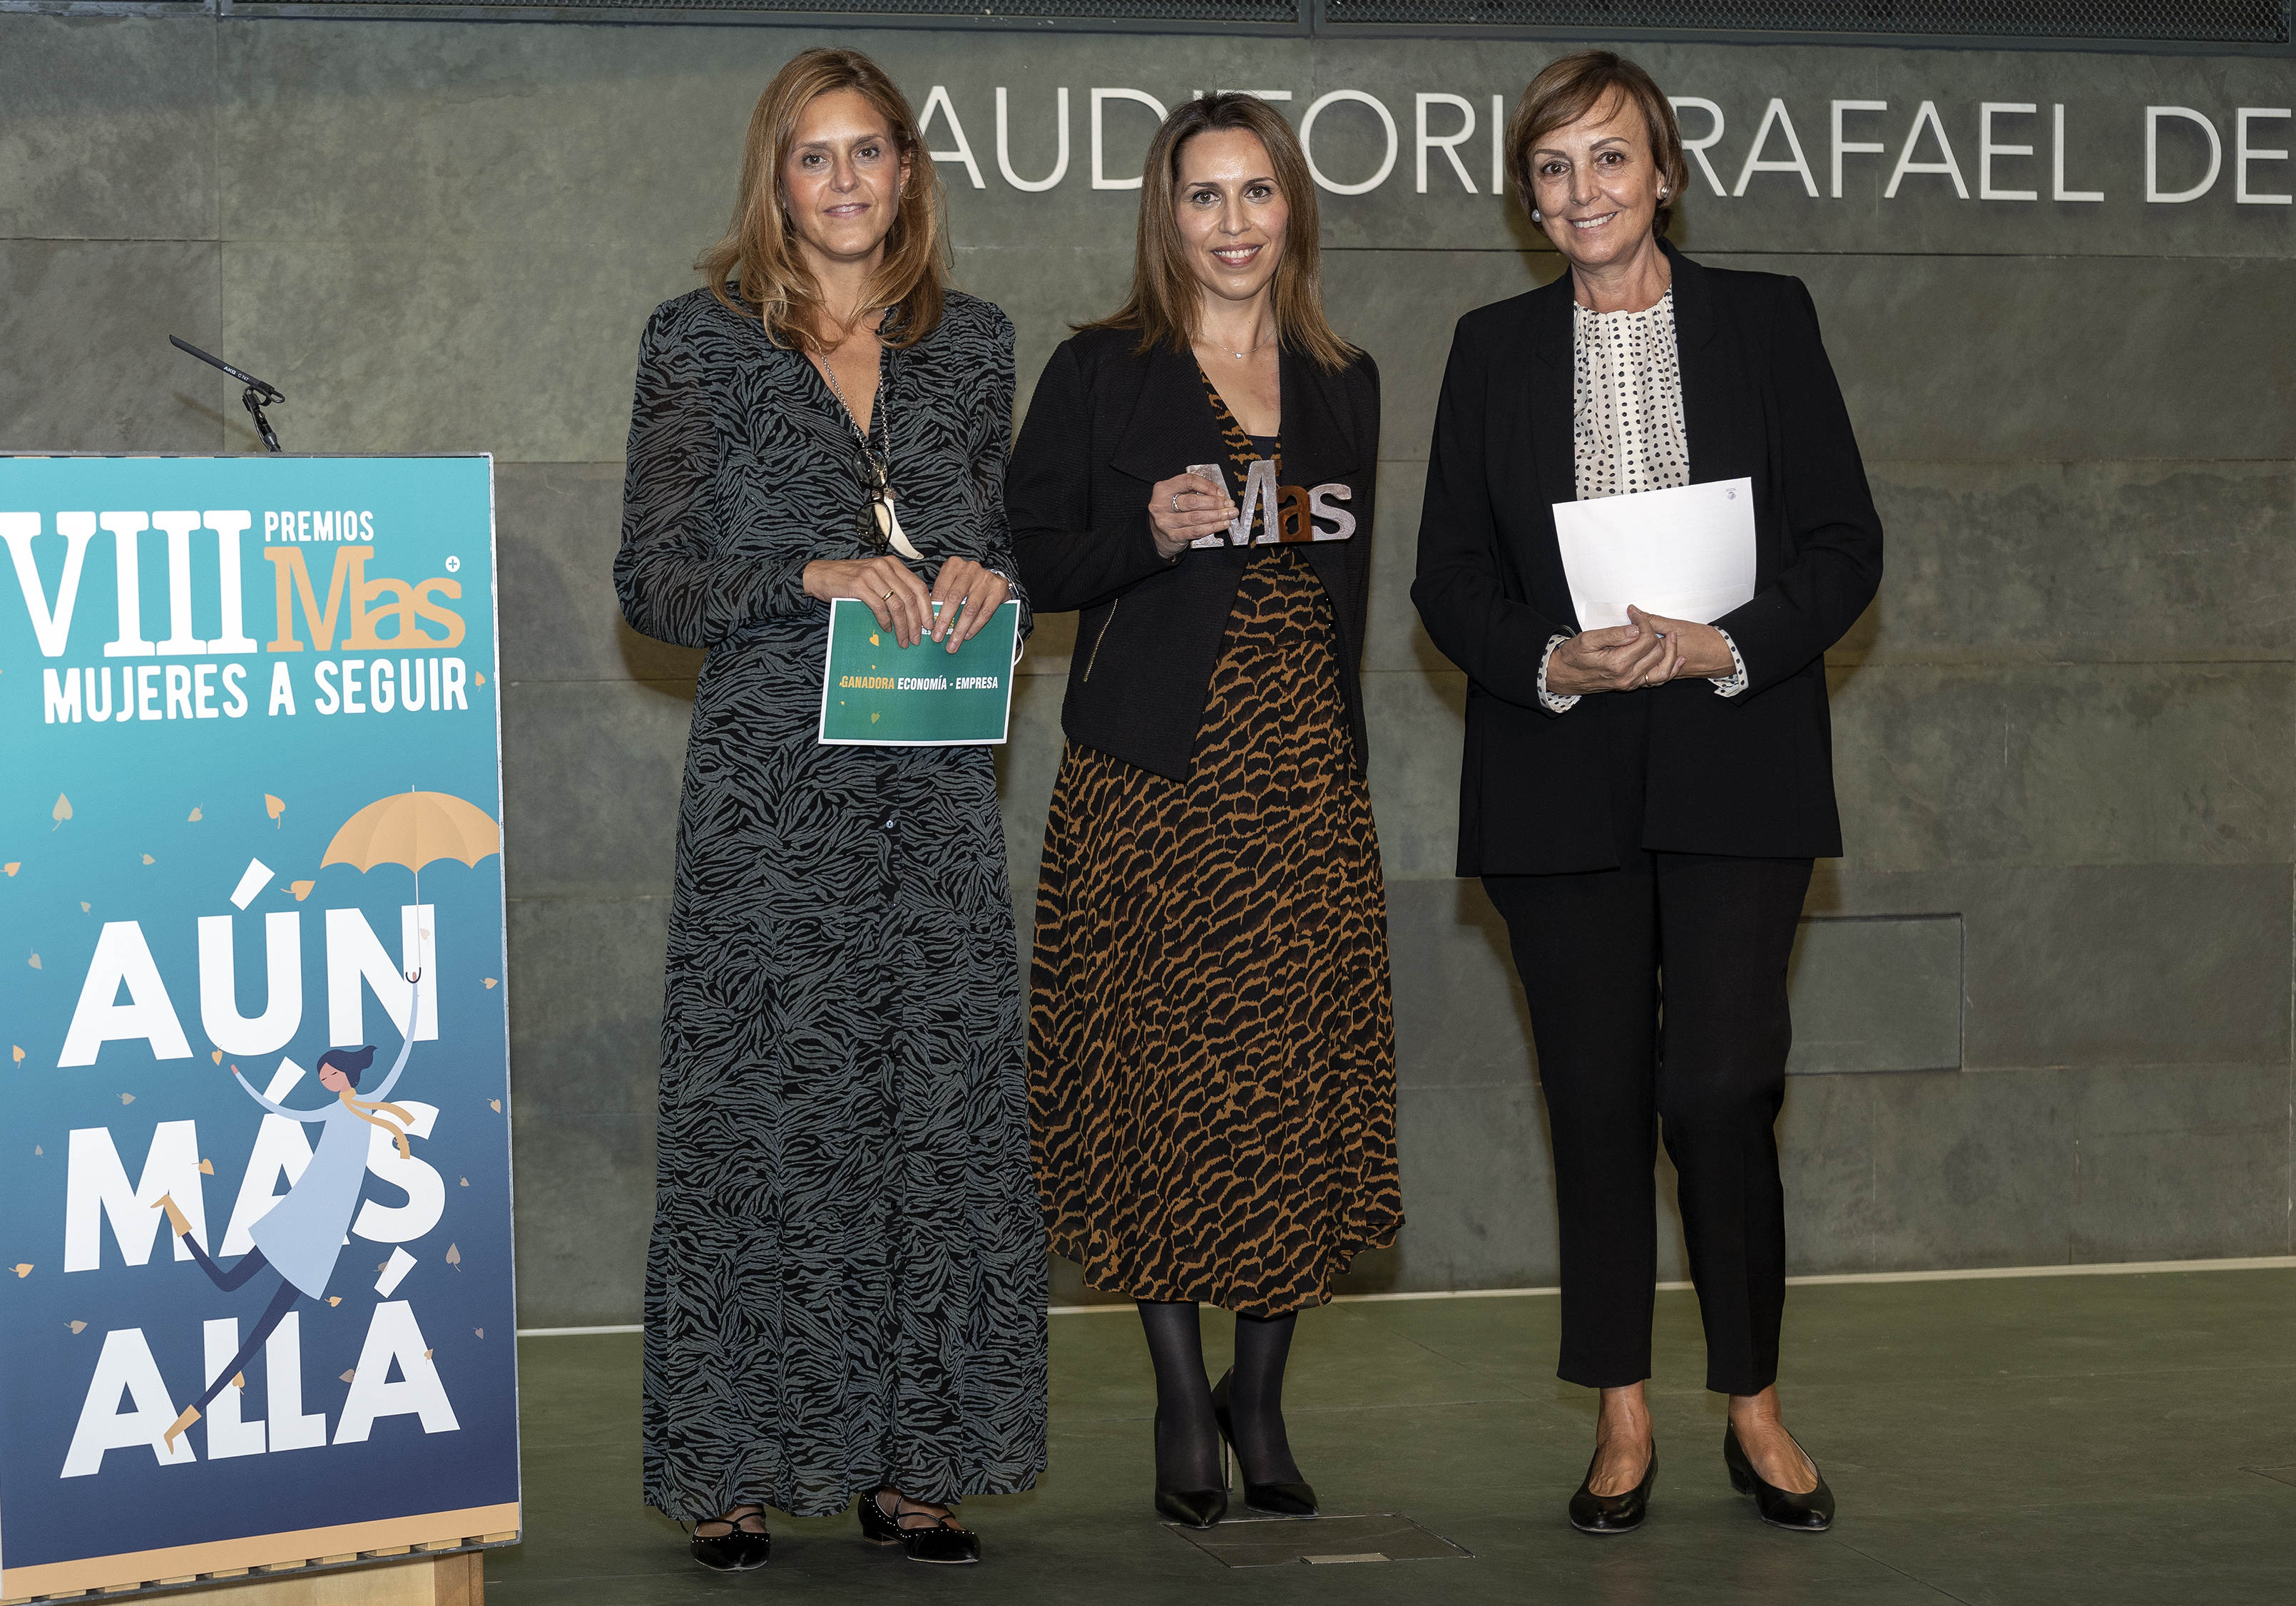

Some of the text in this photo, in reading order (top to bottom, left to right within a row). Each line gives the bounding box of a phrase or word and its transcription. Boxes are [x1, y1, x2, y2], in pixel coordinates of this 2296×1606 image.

[1667, 97, 2105, 202] RAFAEL
[2146, 106, 2293, 204] DE
[265, 511, 374, 542] PREMIOS
[0, 510, 257, 658] VIII
[264, 546, 466, 652] Mas
[44, 658, 469, 724] MUJERES A SEGUIR
[841, 675, 895, 690] GANADORA
[897, 675, 947, 690] ECONOMÍA
[956, 677, 999, 690] EMPRESA
[57, 858, 439, 1068] AÚN
[64, 1056, 446, 1273] MÁS
[60, 1246, 461, 1478] ALLÁ
